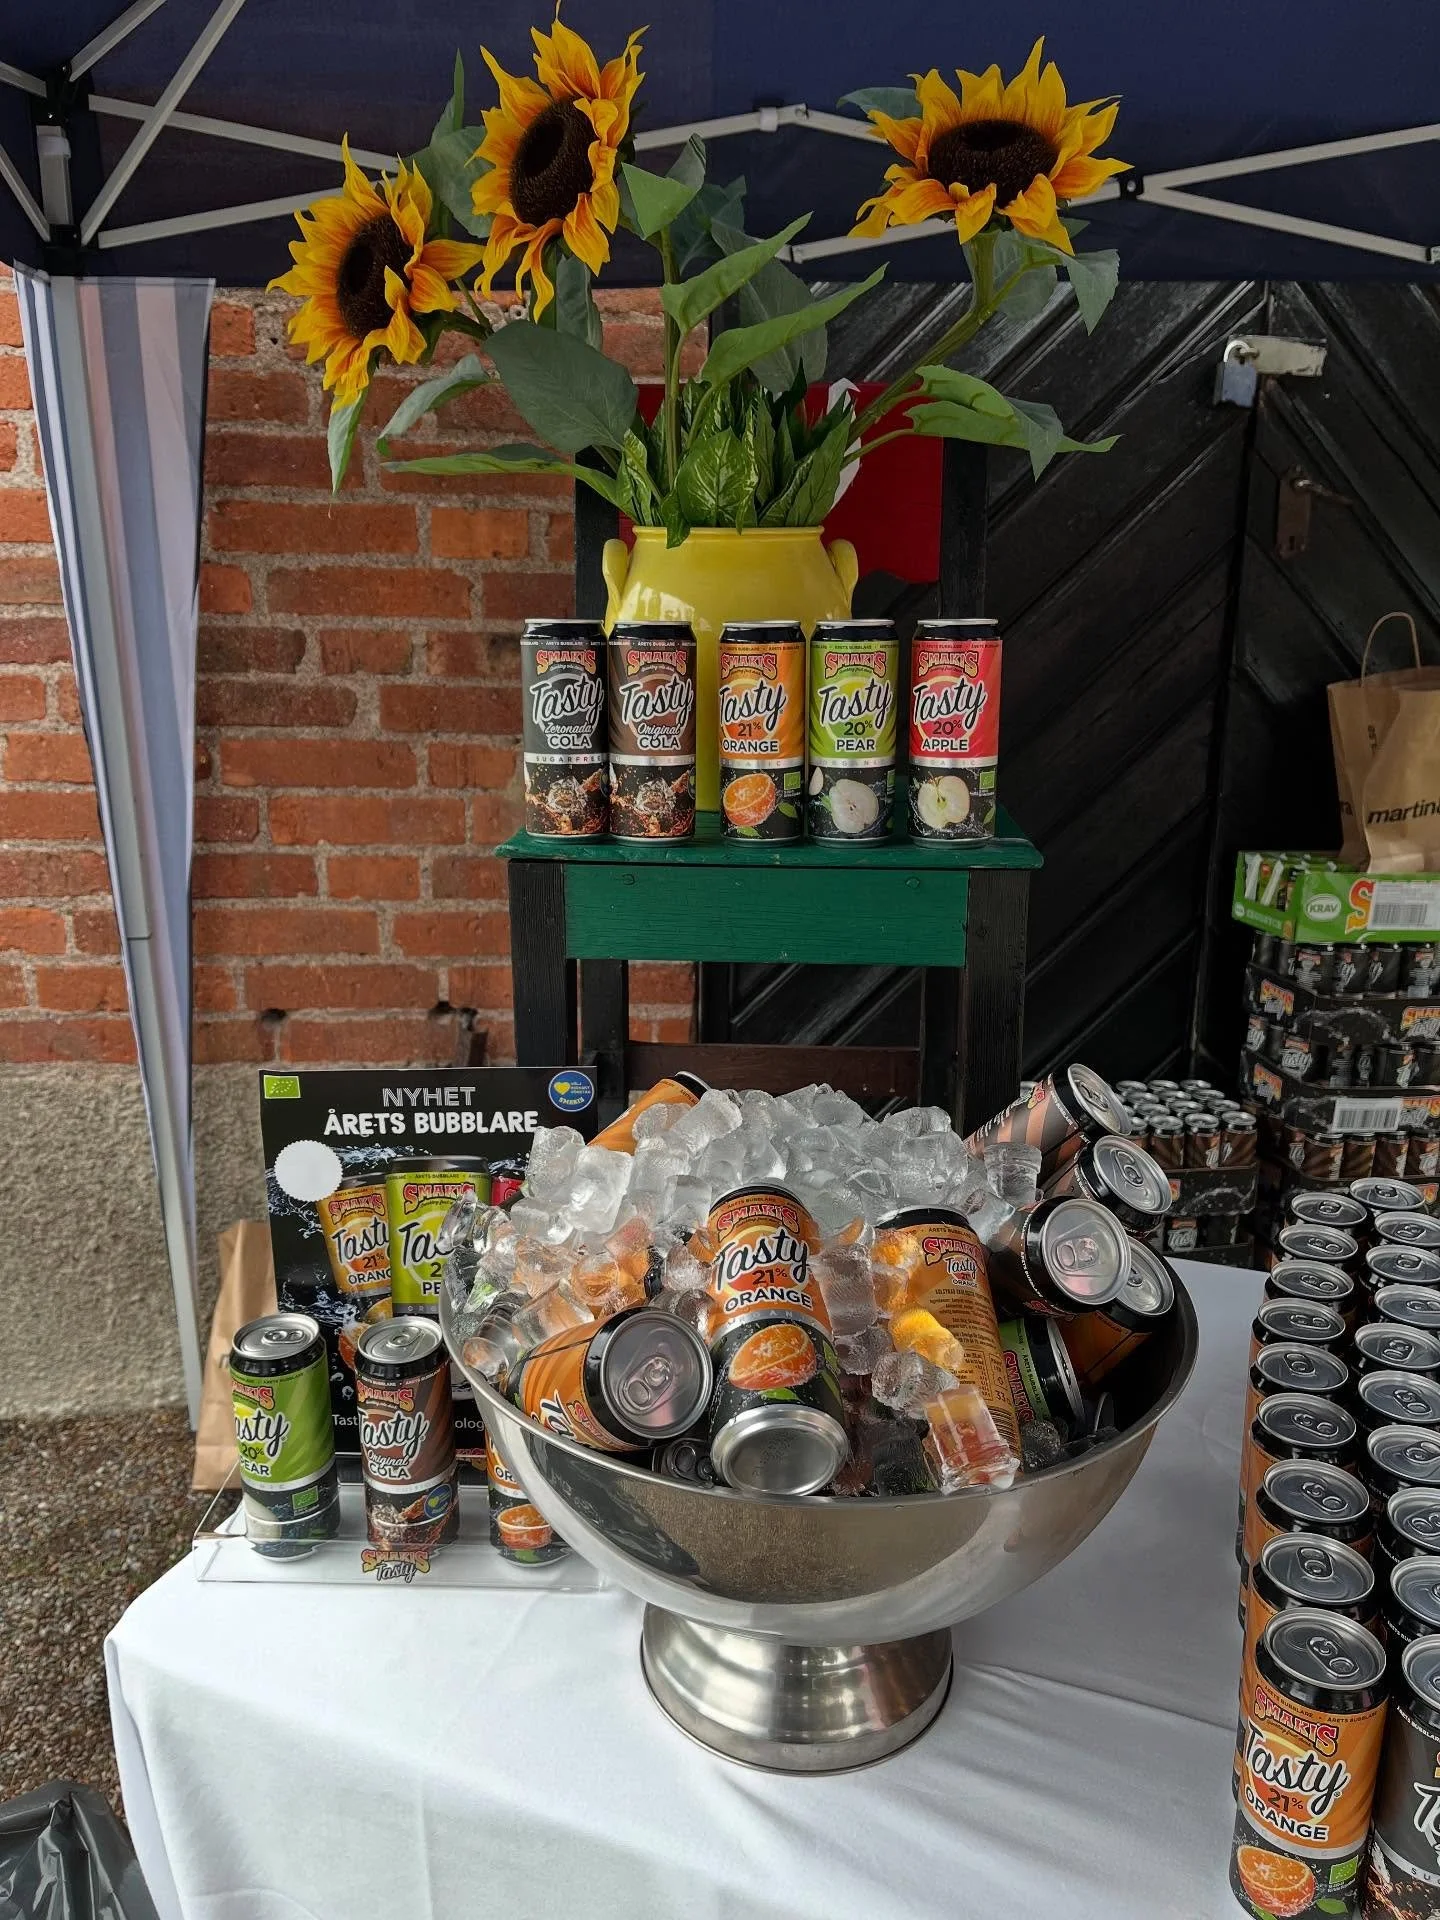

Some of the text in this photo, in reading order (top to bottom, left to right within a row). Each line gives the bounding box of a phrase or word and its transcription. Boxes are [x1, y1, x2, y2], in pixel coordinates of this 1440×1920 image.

[530, 676, 604, 725] Tasty
[619, 676, 693, 727] Tasty
[720, 679, 787, 732] Tasty
[818, 678, 892, 730] Tasty
[914, 677, 986, 729] Tasty
[545, 722, 592, 734] Zeronada
[638, 722, 681, 740] Original
[843, 720, 873, 737] 20%
[932, 720, 962, 736] 20%
[549, 735, 591, 748] COLA
[638, 736, 681, 749] COLA
[722, 739, 779, 752] ORANGE
[836, 739, 876, 751] PEAR
[922, 739, 968, 751] APPLE
[535, 755, 601, 763] SUGARFREE
[1308, 904, 1338, 913] KRAV
[382, 1086, 476, 1107] NYHET
[323, 1108, 539, 1137] ÅRETS BUBBLARE
[714, 1228, 810, 1291] Tasty
[944, 1256, 977, 1279] Tasty
[752, 1267, 788, 1285] 21%
[422, 1281, 440, 1294] PE
[725, 1288, 813, 1312] ORANGE
[234, 1408, 290, 1458] asty
[331, 1414, 485, 1431] Tast olog
[357, 1407, 430, 1459] Tasty
[368, 1450, 409, 1467] Original
[369, 1463, 410, 1478] COLA
[376, 1561, 417, 1583] Tasty
[1411, 1721, 1440, 1743] BUBBLAR
[1247, 1718, 1350, 1818] Tasty
[1268, 1787, 1304, 1813] 21%
[1245, 1785, 1328, 1841] ORANGE
